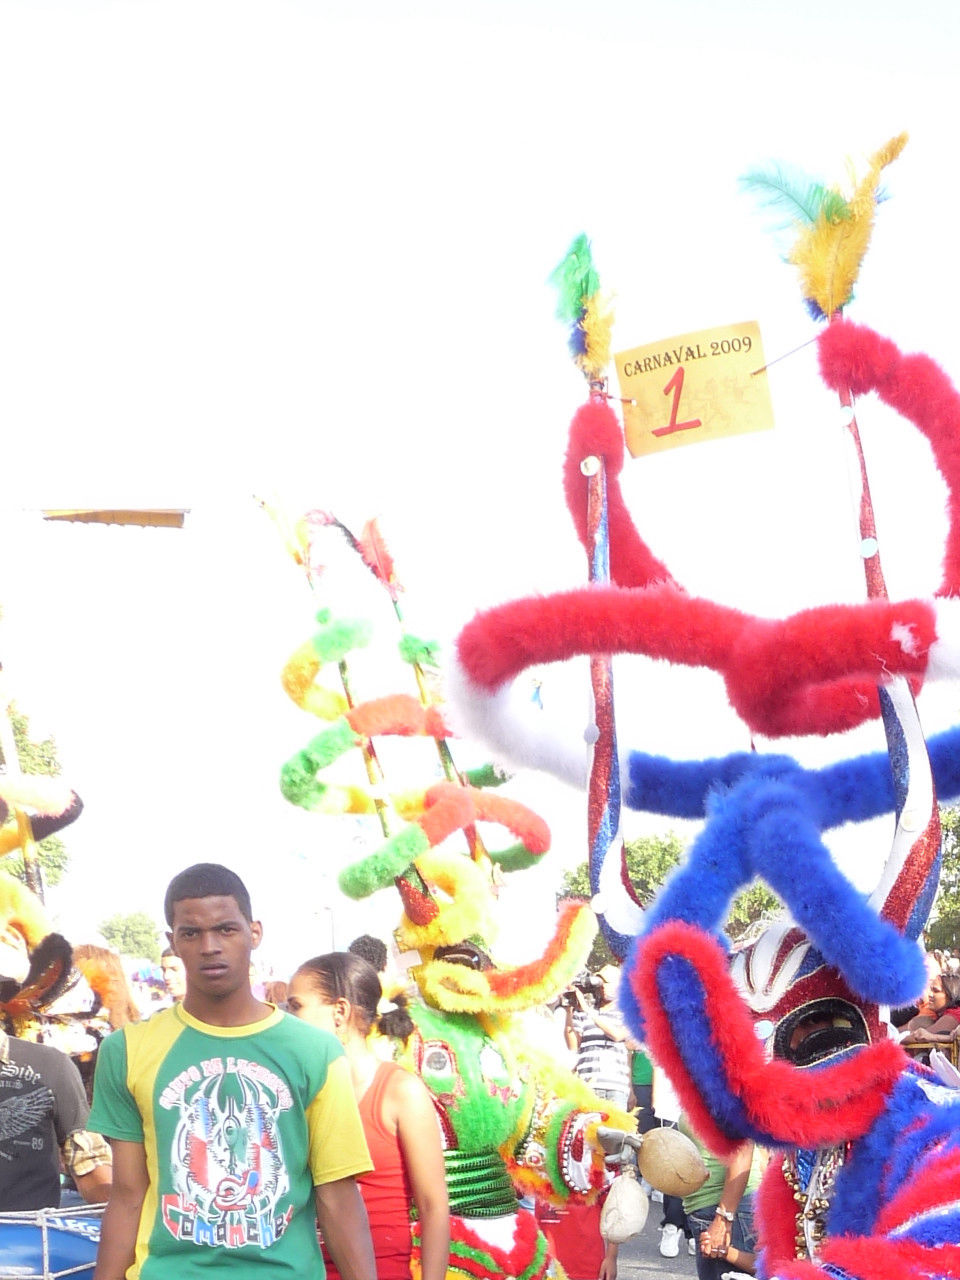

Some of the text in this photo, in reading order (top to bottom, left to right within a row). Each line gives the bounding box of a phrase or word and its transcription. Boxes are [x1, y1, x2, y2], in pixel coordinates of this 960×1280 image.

[623, 335, 753, 378] CARNAVAL 2009
[651, 365, 702, 438] 1
